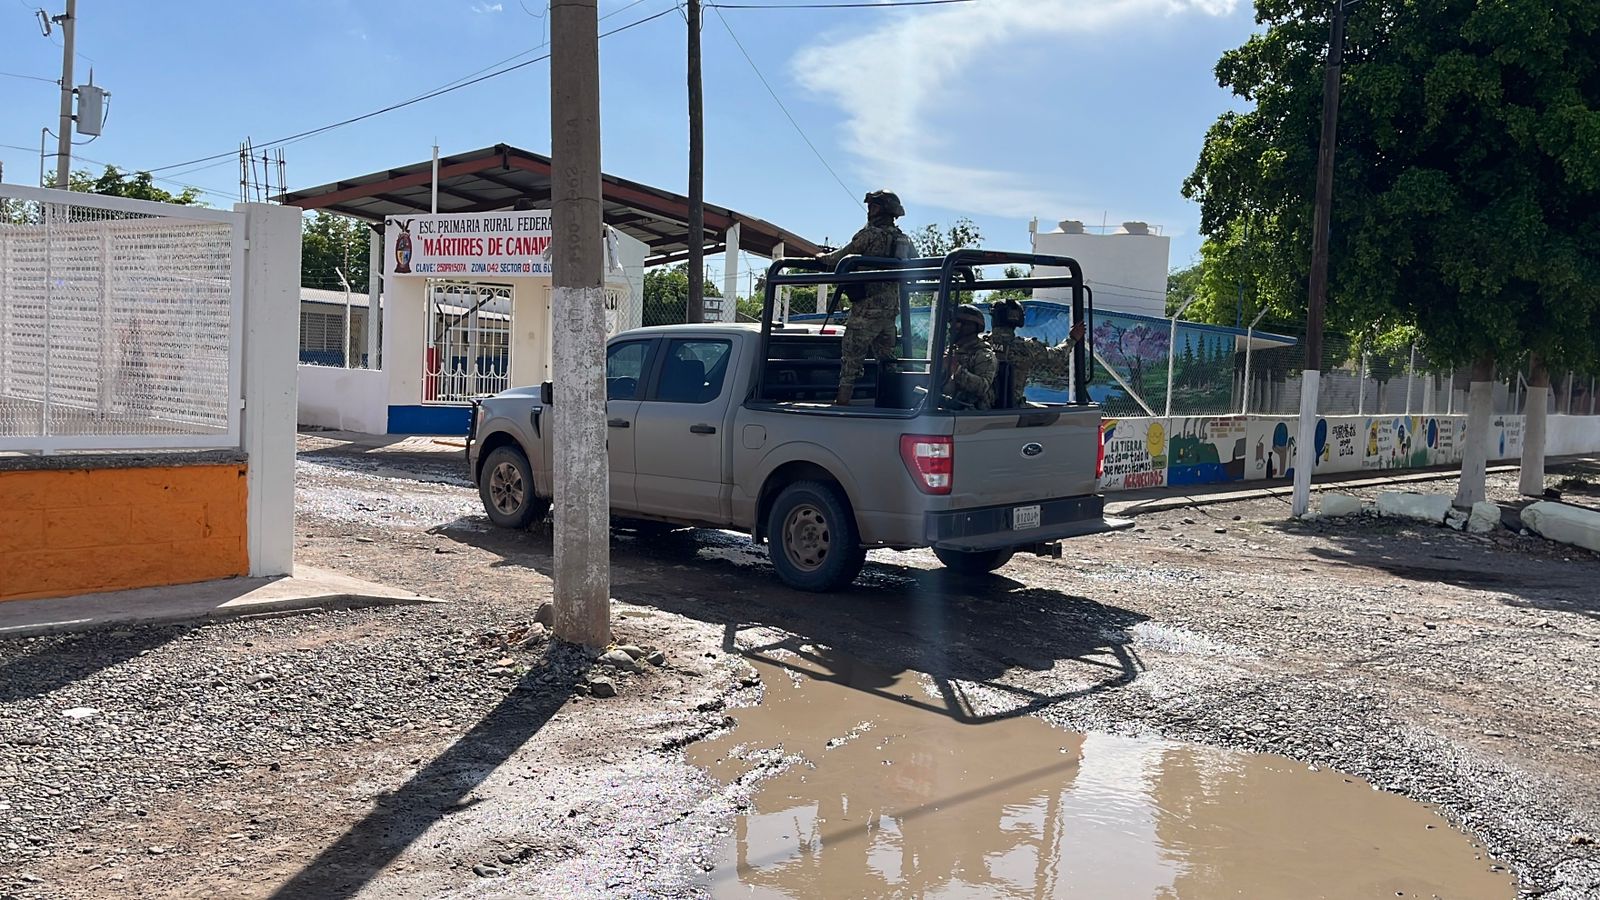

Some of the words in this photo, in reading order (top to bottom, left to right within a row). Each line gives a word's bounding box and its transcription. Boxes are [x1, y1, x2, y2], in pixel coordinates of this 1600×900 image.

[419, 220, 436, 234] ESC.
[438, 218, 481, 233] PRIMARIA
[483, 217, 514, 232] RURAL
[488, 237, 503, 255] DE
[415, 263, 436, 273] CLAVE:
[471, 263, 486, 273] ZONA
[486, 263, 499, 273] 042
[500, 263, 522, 273] SECTOR
[522, 263, 531, 273] 03
[531, 263, 543, 273] COL
[1111, 441, 1119, 453] LA
[1120, 440, 1143, 452] TIERRA
